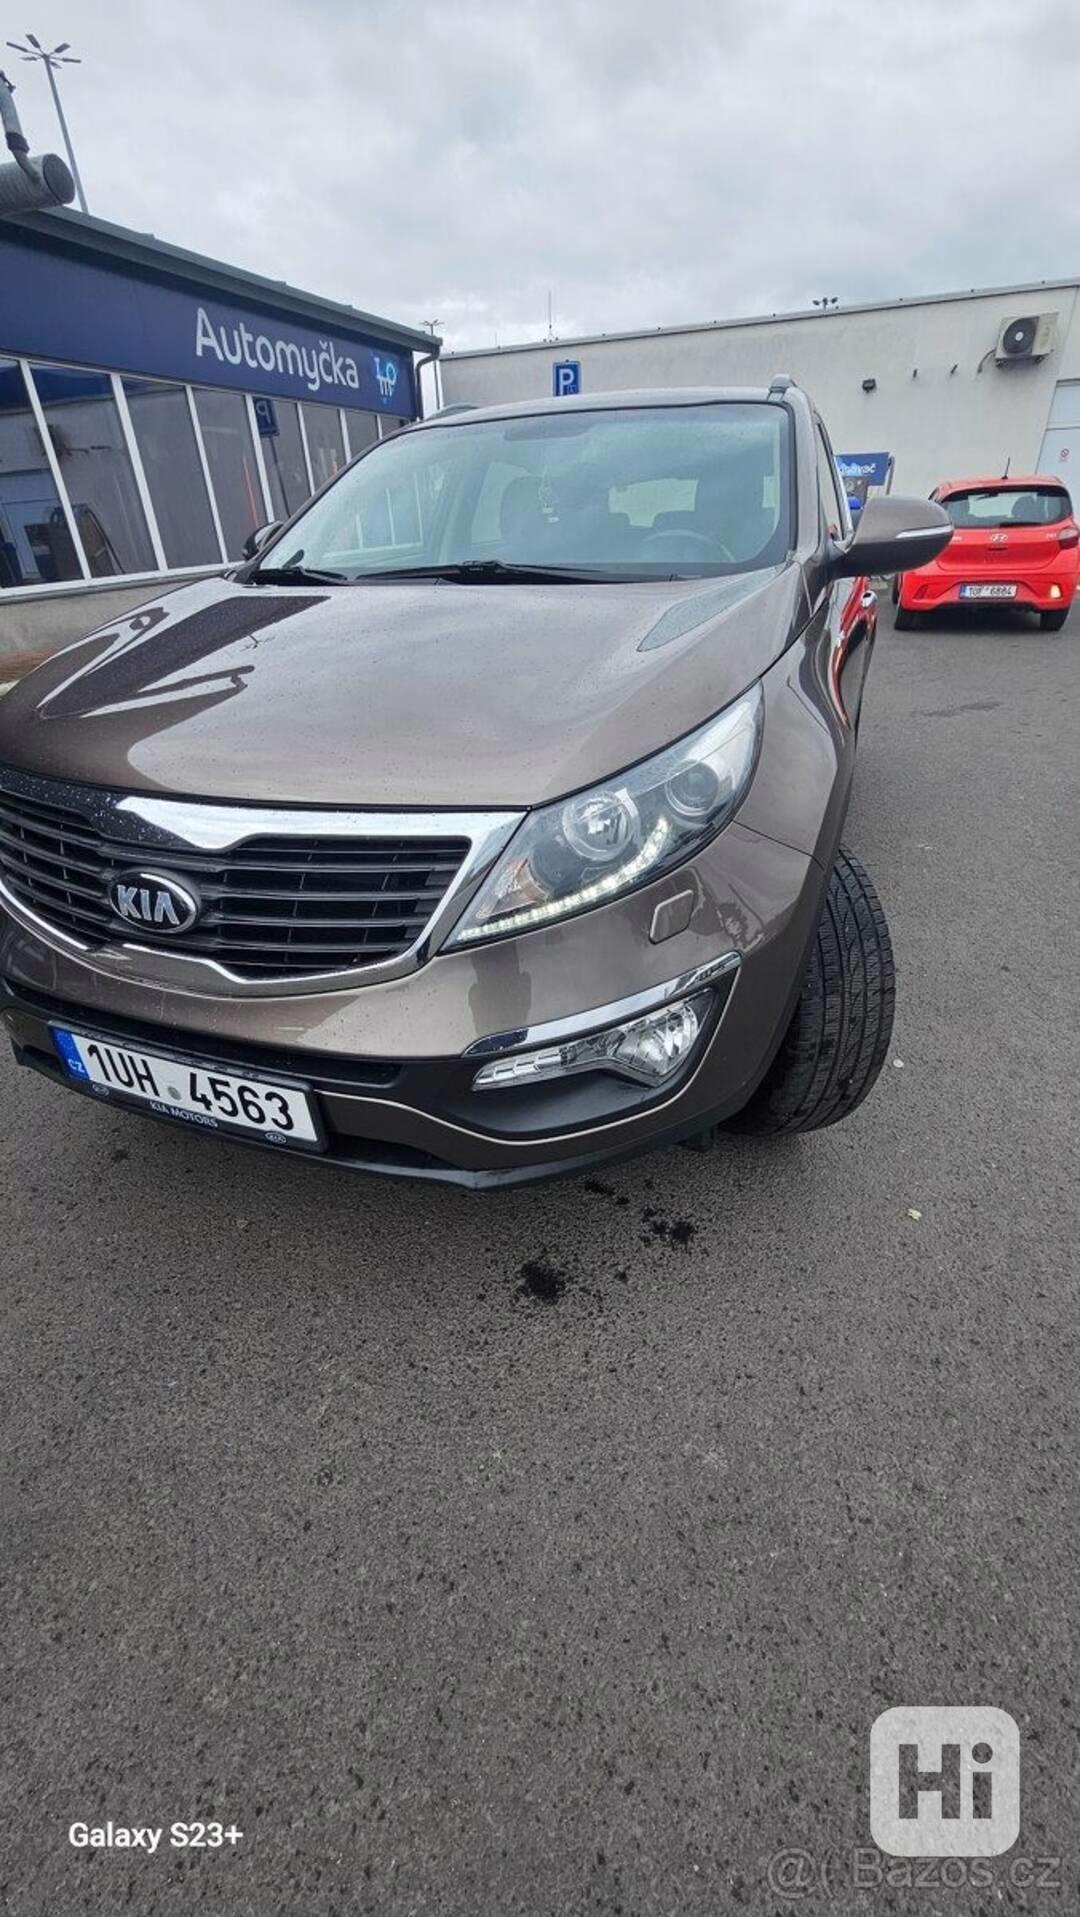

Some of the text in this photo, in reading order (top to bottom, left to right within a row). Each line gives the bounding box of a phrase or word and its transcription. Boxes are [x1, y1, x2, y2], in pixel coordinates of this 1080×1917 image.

[195, 307, 360, 392] Automyčka
[559, 368, 575, 396] P
[116, 884, 180, 925] KIA
[67, 1058, 86, 1073] CZ
[87, 1044, 295, 1131] 1UH 4563
[149, 1100, 219, 1128] KIA MOTORS
